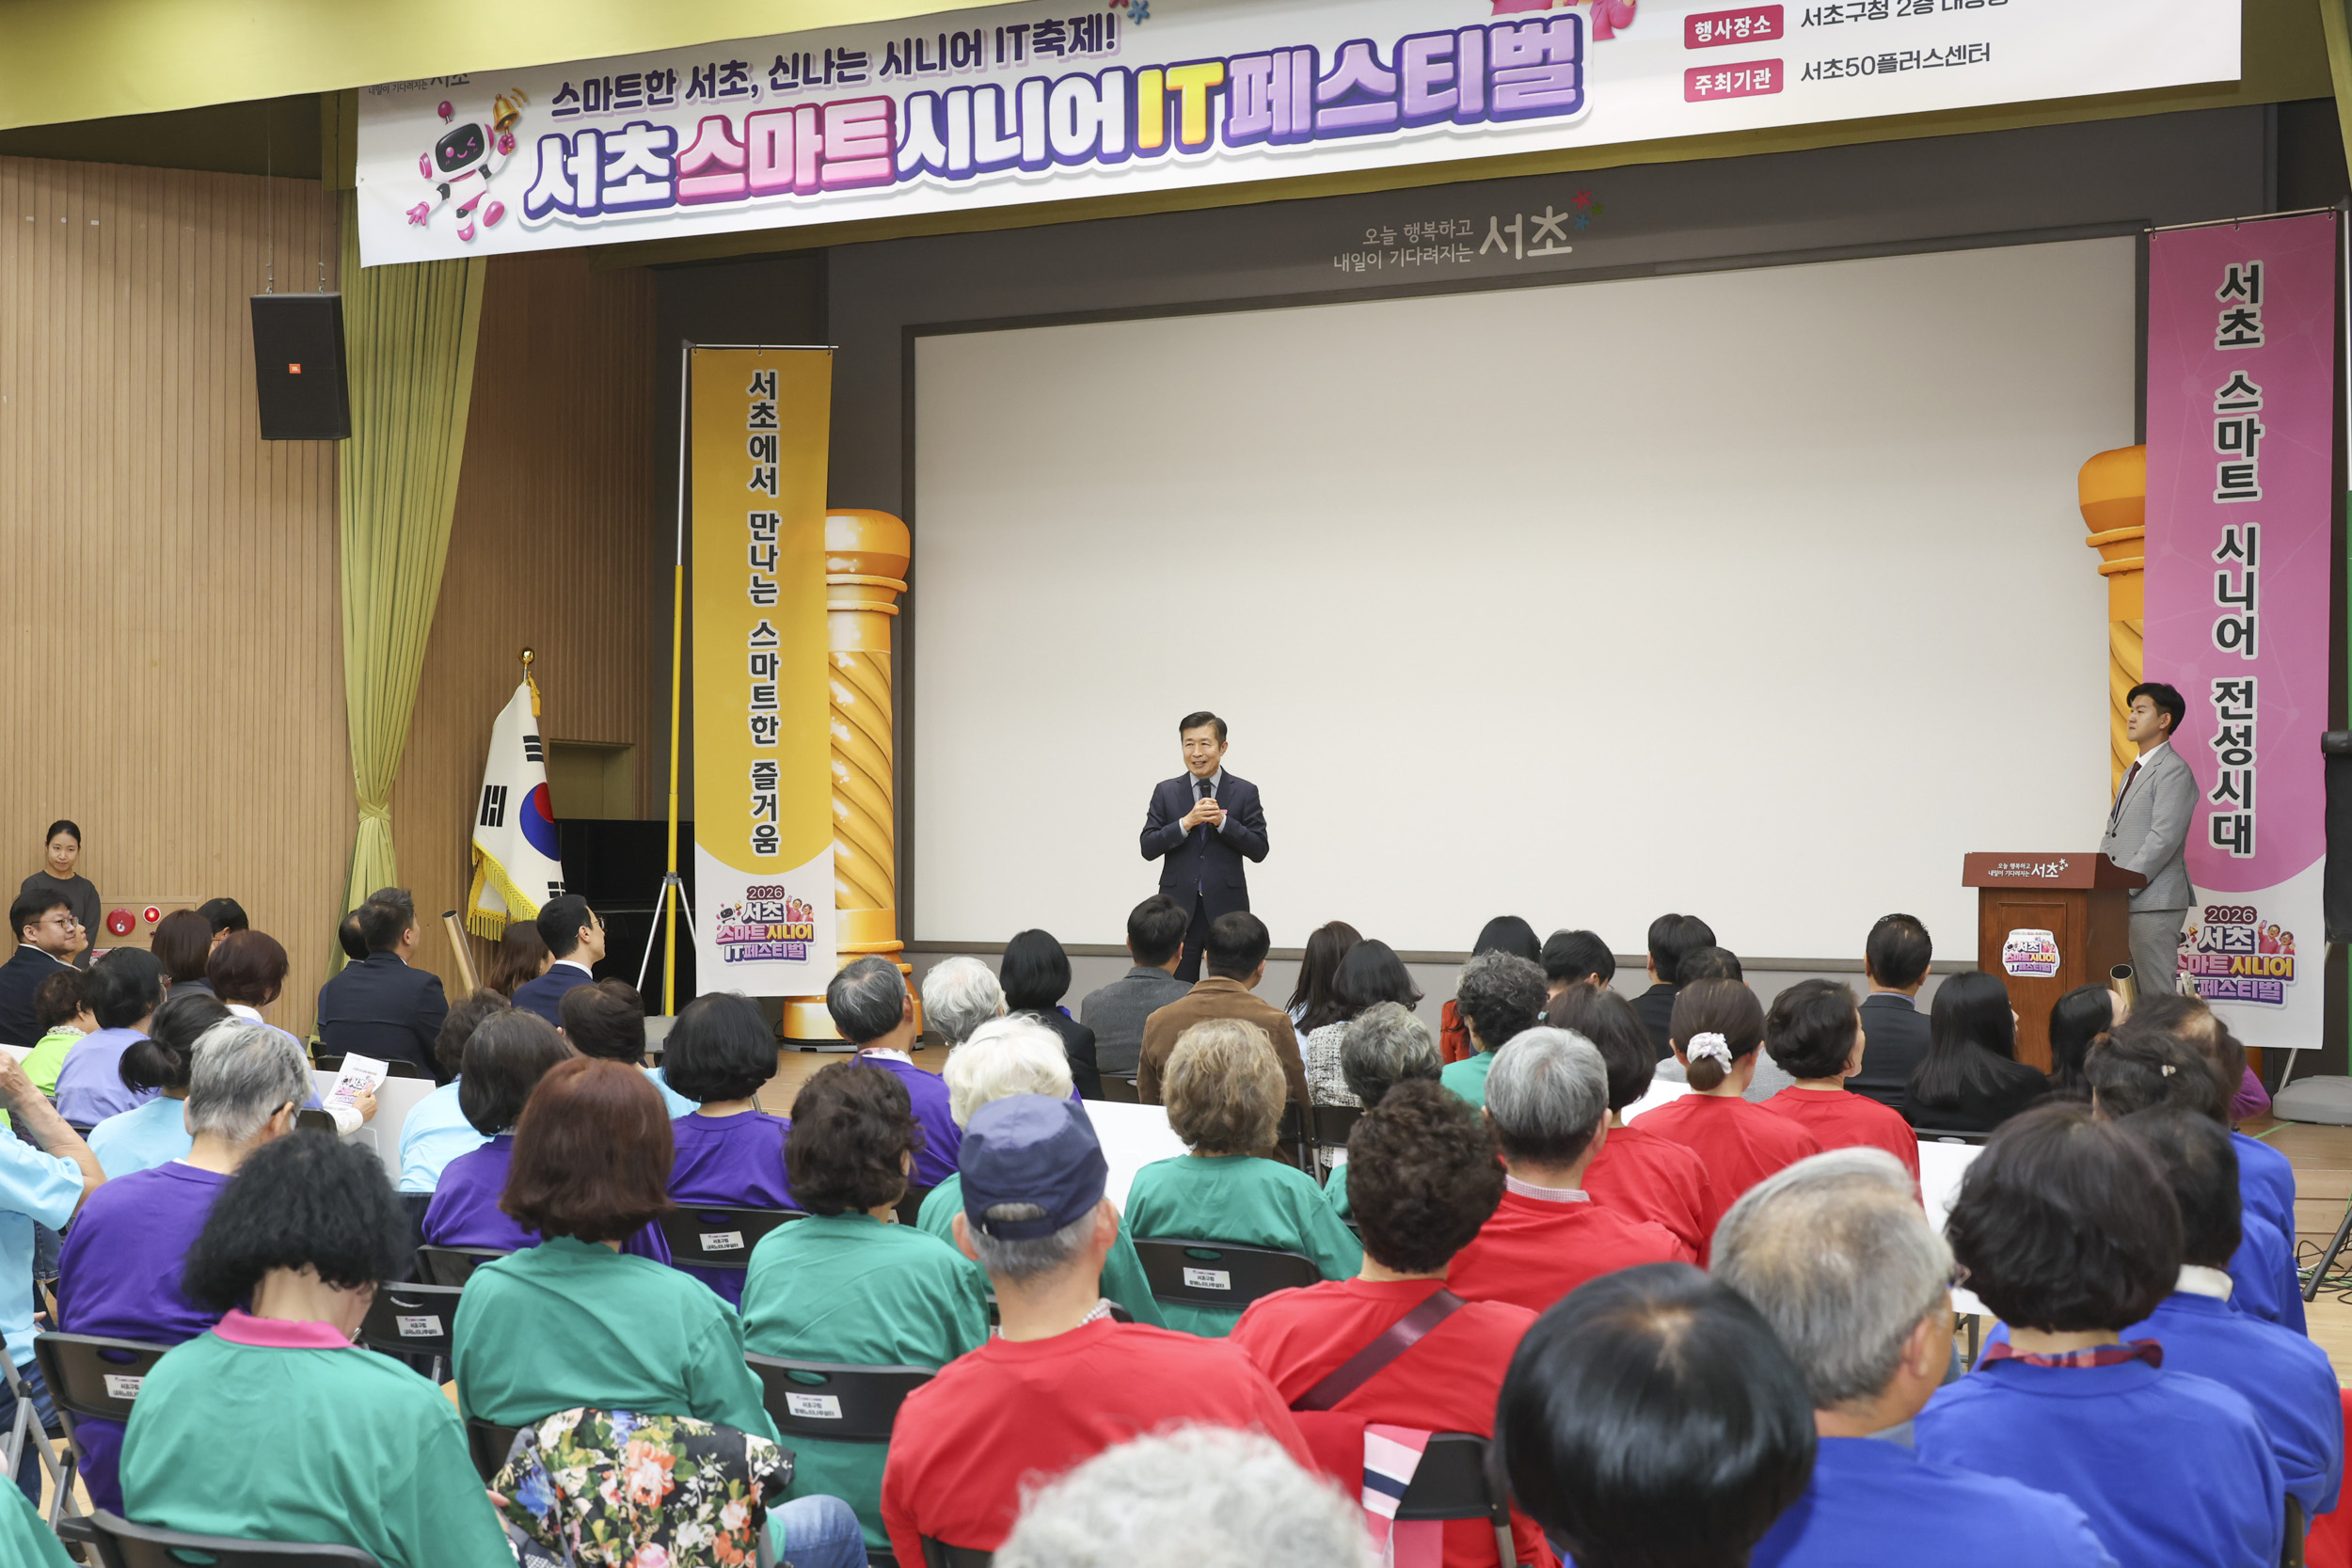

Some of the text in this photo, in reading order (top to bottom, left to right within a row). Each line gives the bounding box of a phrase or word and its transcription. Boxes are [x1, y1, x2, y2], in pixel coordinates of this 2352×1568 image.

[1694, 15, 1772, 42] 행사장소
[1801, 0, 1889, 28] 서초구청
[551, 12, 1116, 117] 스마트한 서초, 신나는 시니어 IT축제!
[1694, 42, 1992, 96] 주최기관 서초50플러스센터
[392, 80, 429, 92] 기다려지는
[1362, 218, 1474, 245] 오늘 행복하고
[1479, 205, 1573, 261] 서초
[1333, 243, 1474, 273] 내일이 기다려지는
[2211, 262, 2263, 856] 서초 스마트 시니어 전성시대
[748, 371, 781, 855] 서초에서 만나는 스마트한 즐거움
[2031, 862, 2059, 878] 서초
[748, 886, 784, 899] 2026
[741, 902, 783, 923] 서초
[2206, 907, 2256, 924] 2026
[716, 924, 813, 942] 스마트시니어
[2199, 927, 2253, 952] 서초
[724, 943, 806, 960] IT페스티벌
[2018, 942, 2040, 953] 서초
